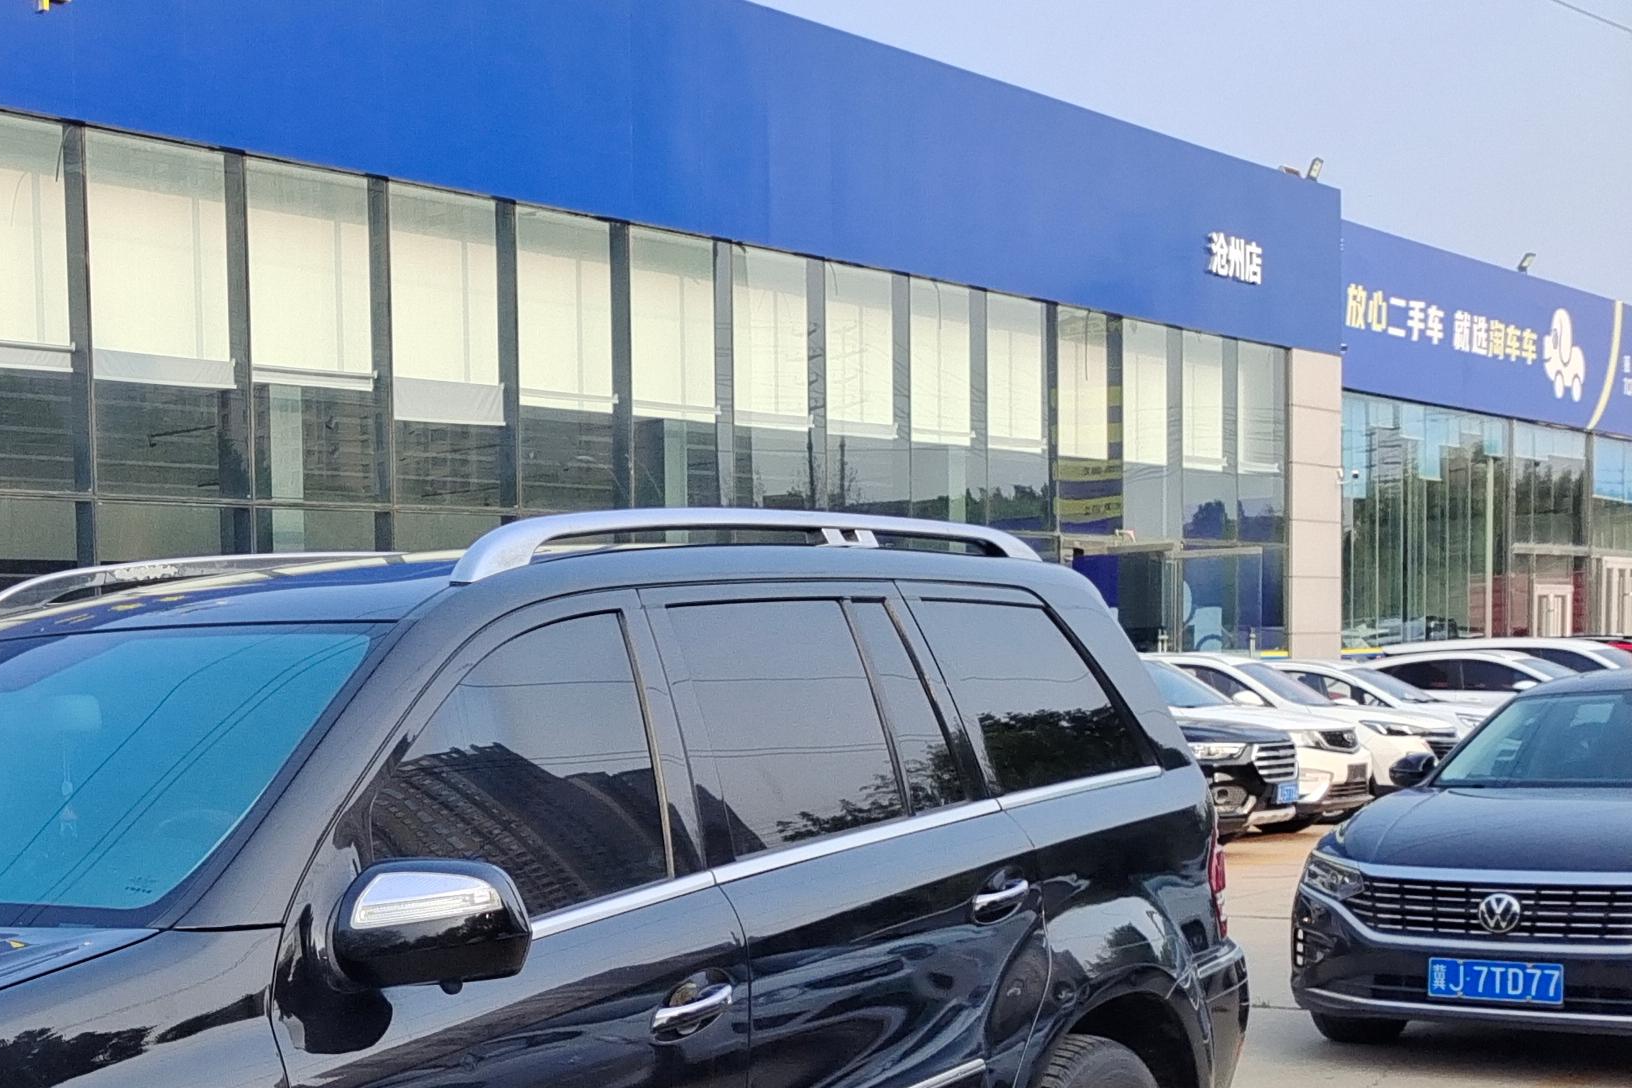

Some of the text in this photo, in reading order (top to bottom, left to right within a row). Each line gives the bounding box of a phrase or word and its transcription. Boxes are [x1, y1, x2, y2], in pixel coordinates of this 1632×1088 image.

[1208, 231, 1263, 285] 沧州店
[1345, 283, 1538, 365] 放心二手车 就选淘车车
